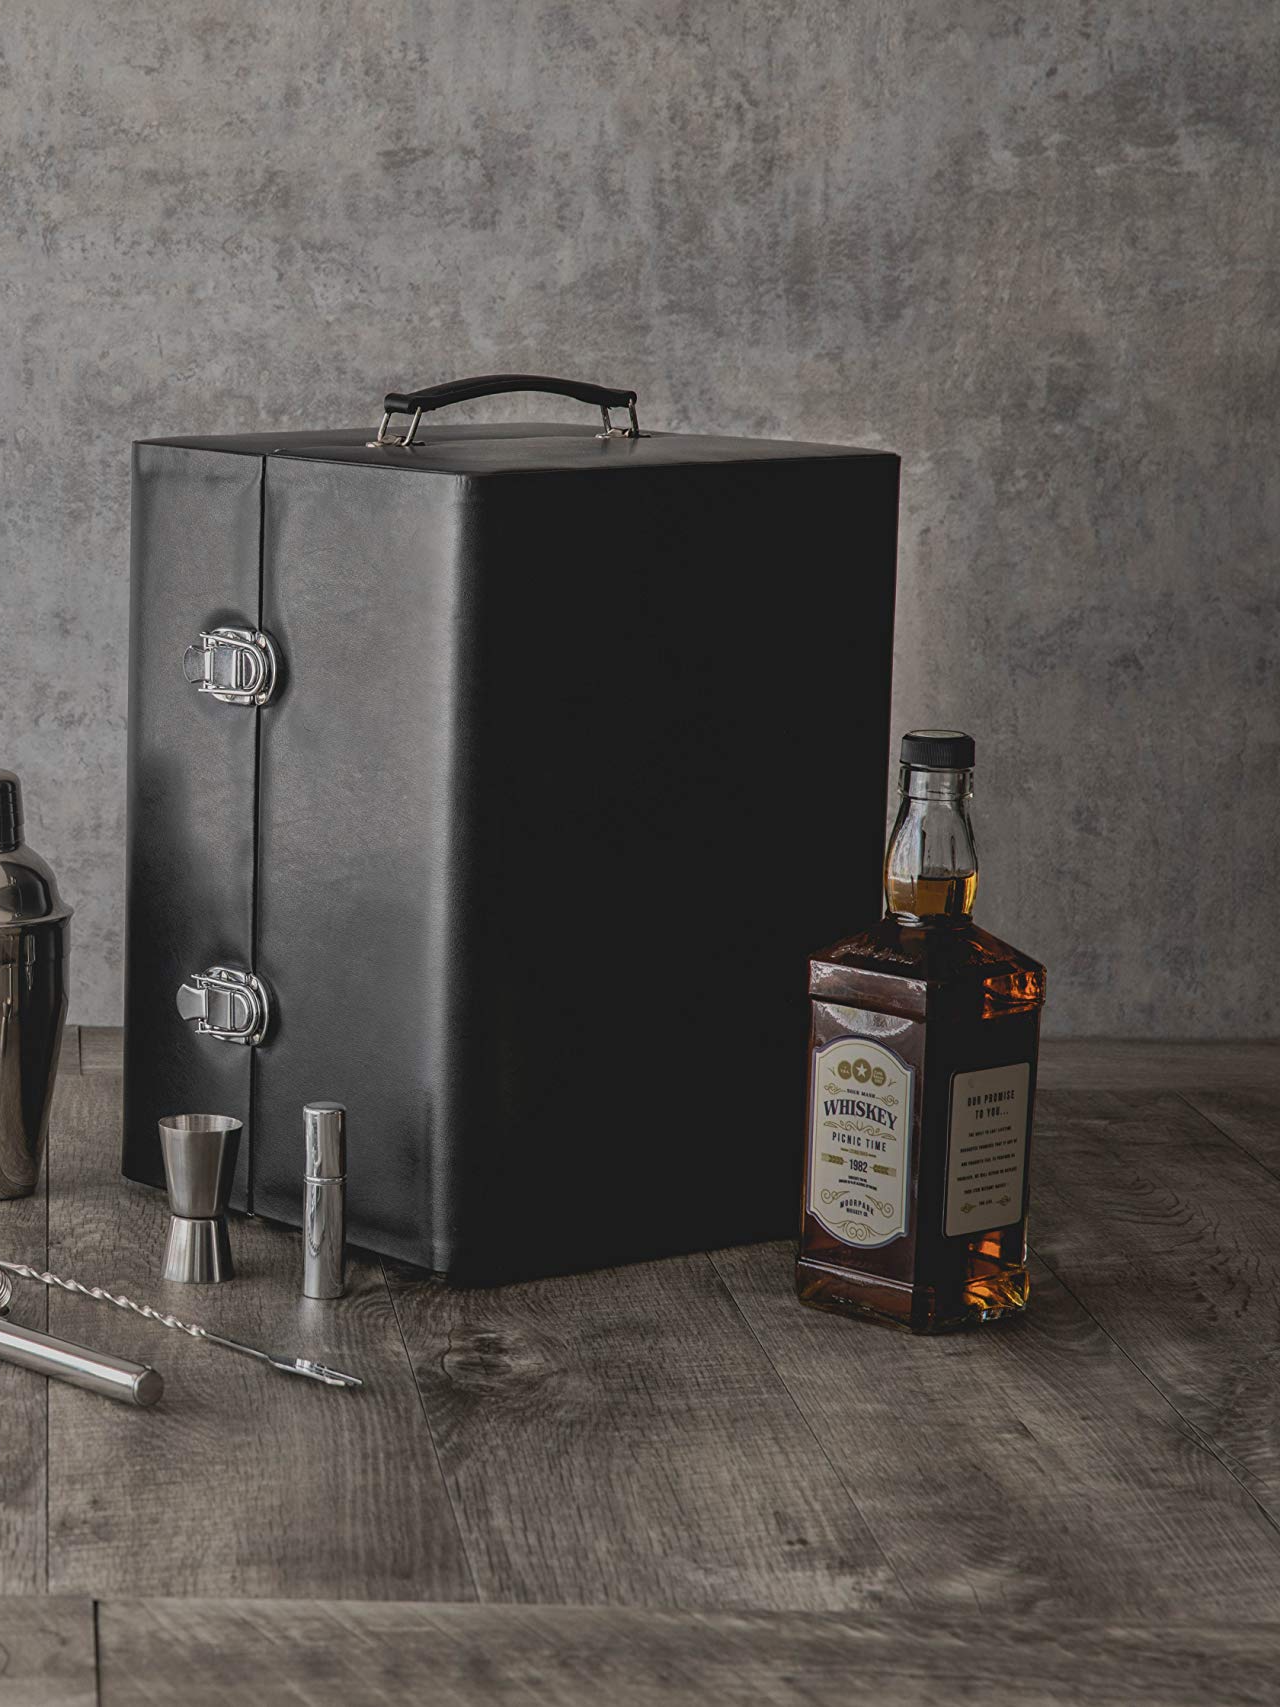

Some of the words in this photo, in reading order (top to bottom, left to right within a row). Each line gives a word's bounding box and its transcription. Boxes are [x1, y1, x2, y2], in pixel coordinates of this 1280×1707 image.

[967, 1095, 981, 1107] OUR
[984, 1089, 1015, 1104] PROMISE
[823, 1099, 898, 1131] WHISKEY
[975, 1108, 984, 1120] TO
[832, 1131, 862, 1147] PICNIC
[866, 1138, 887, 1153] TIME
[849, 1159, 868, 1174] 1982
[840, 1199, 875, 1216] MOORPARK
